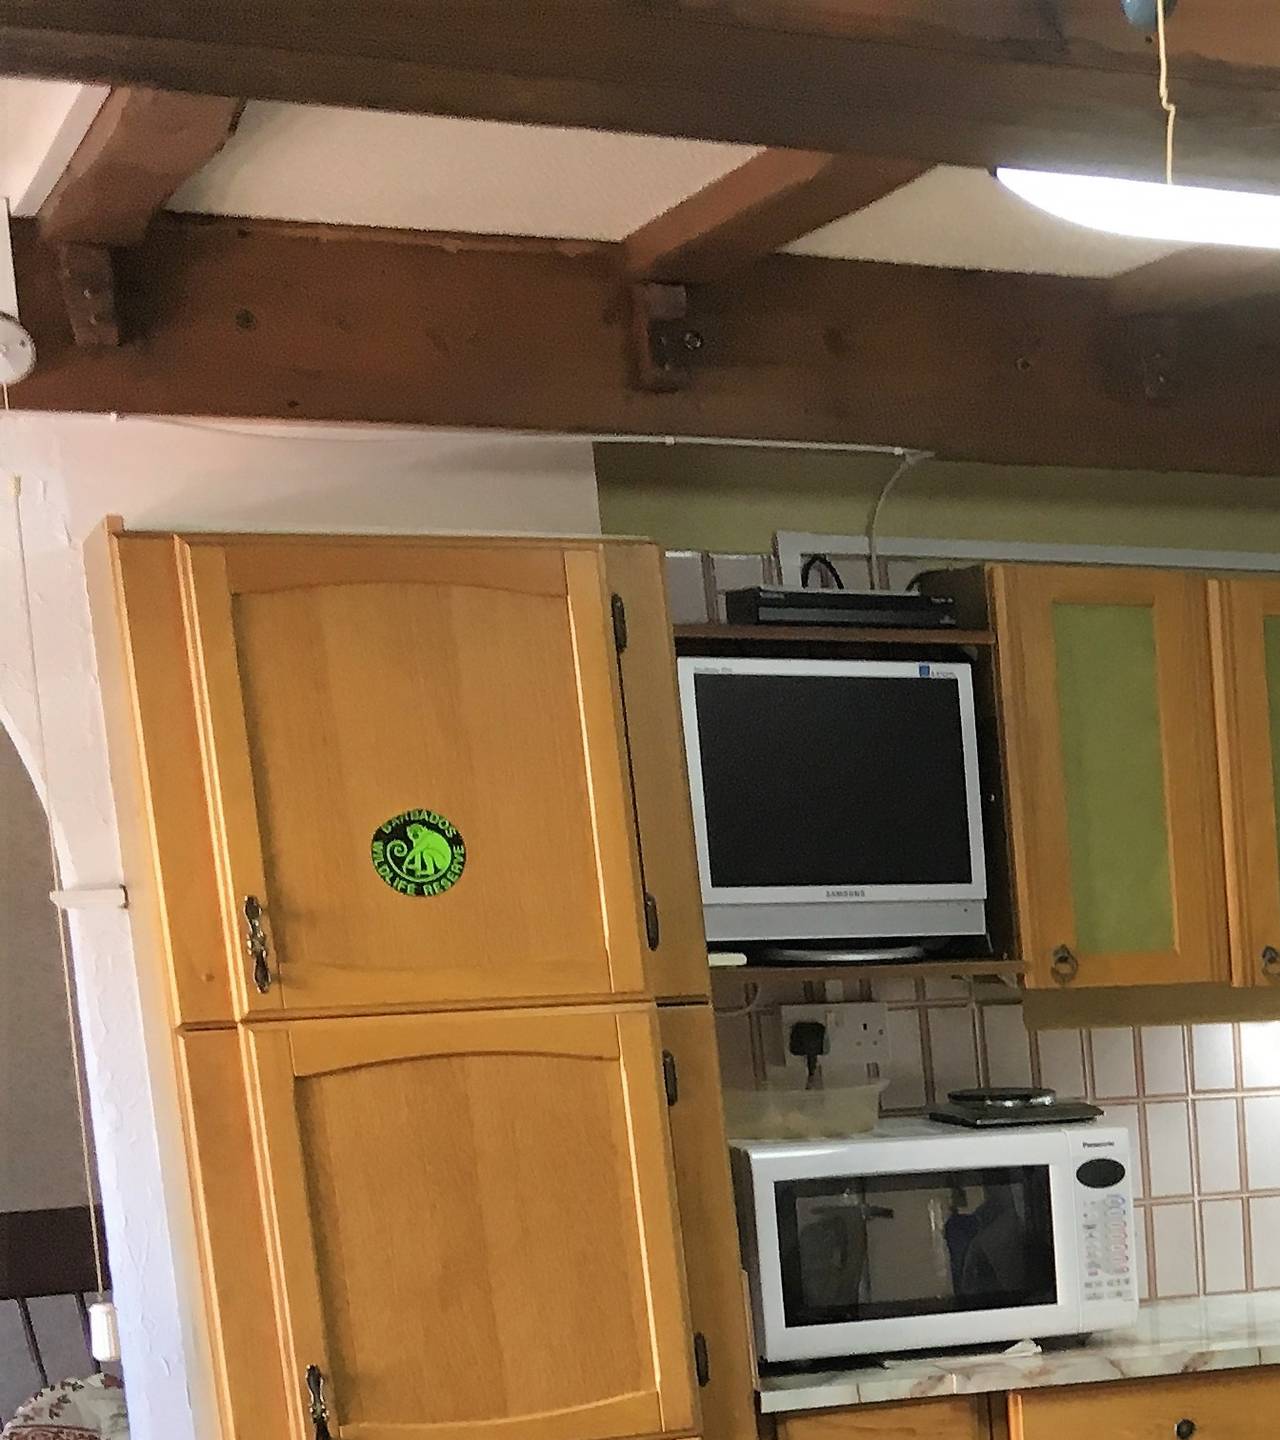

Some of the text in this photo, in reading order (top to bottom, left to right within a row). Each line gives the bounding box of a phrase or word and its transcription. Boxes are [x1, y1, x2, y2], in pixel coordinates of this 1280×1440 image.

[382, 809, 457, 838] BARBADOS
[372, 840, 465, 896] WILDLIFE RESERVE
